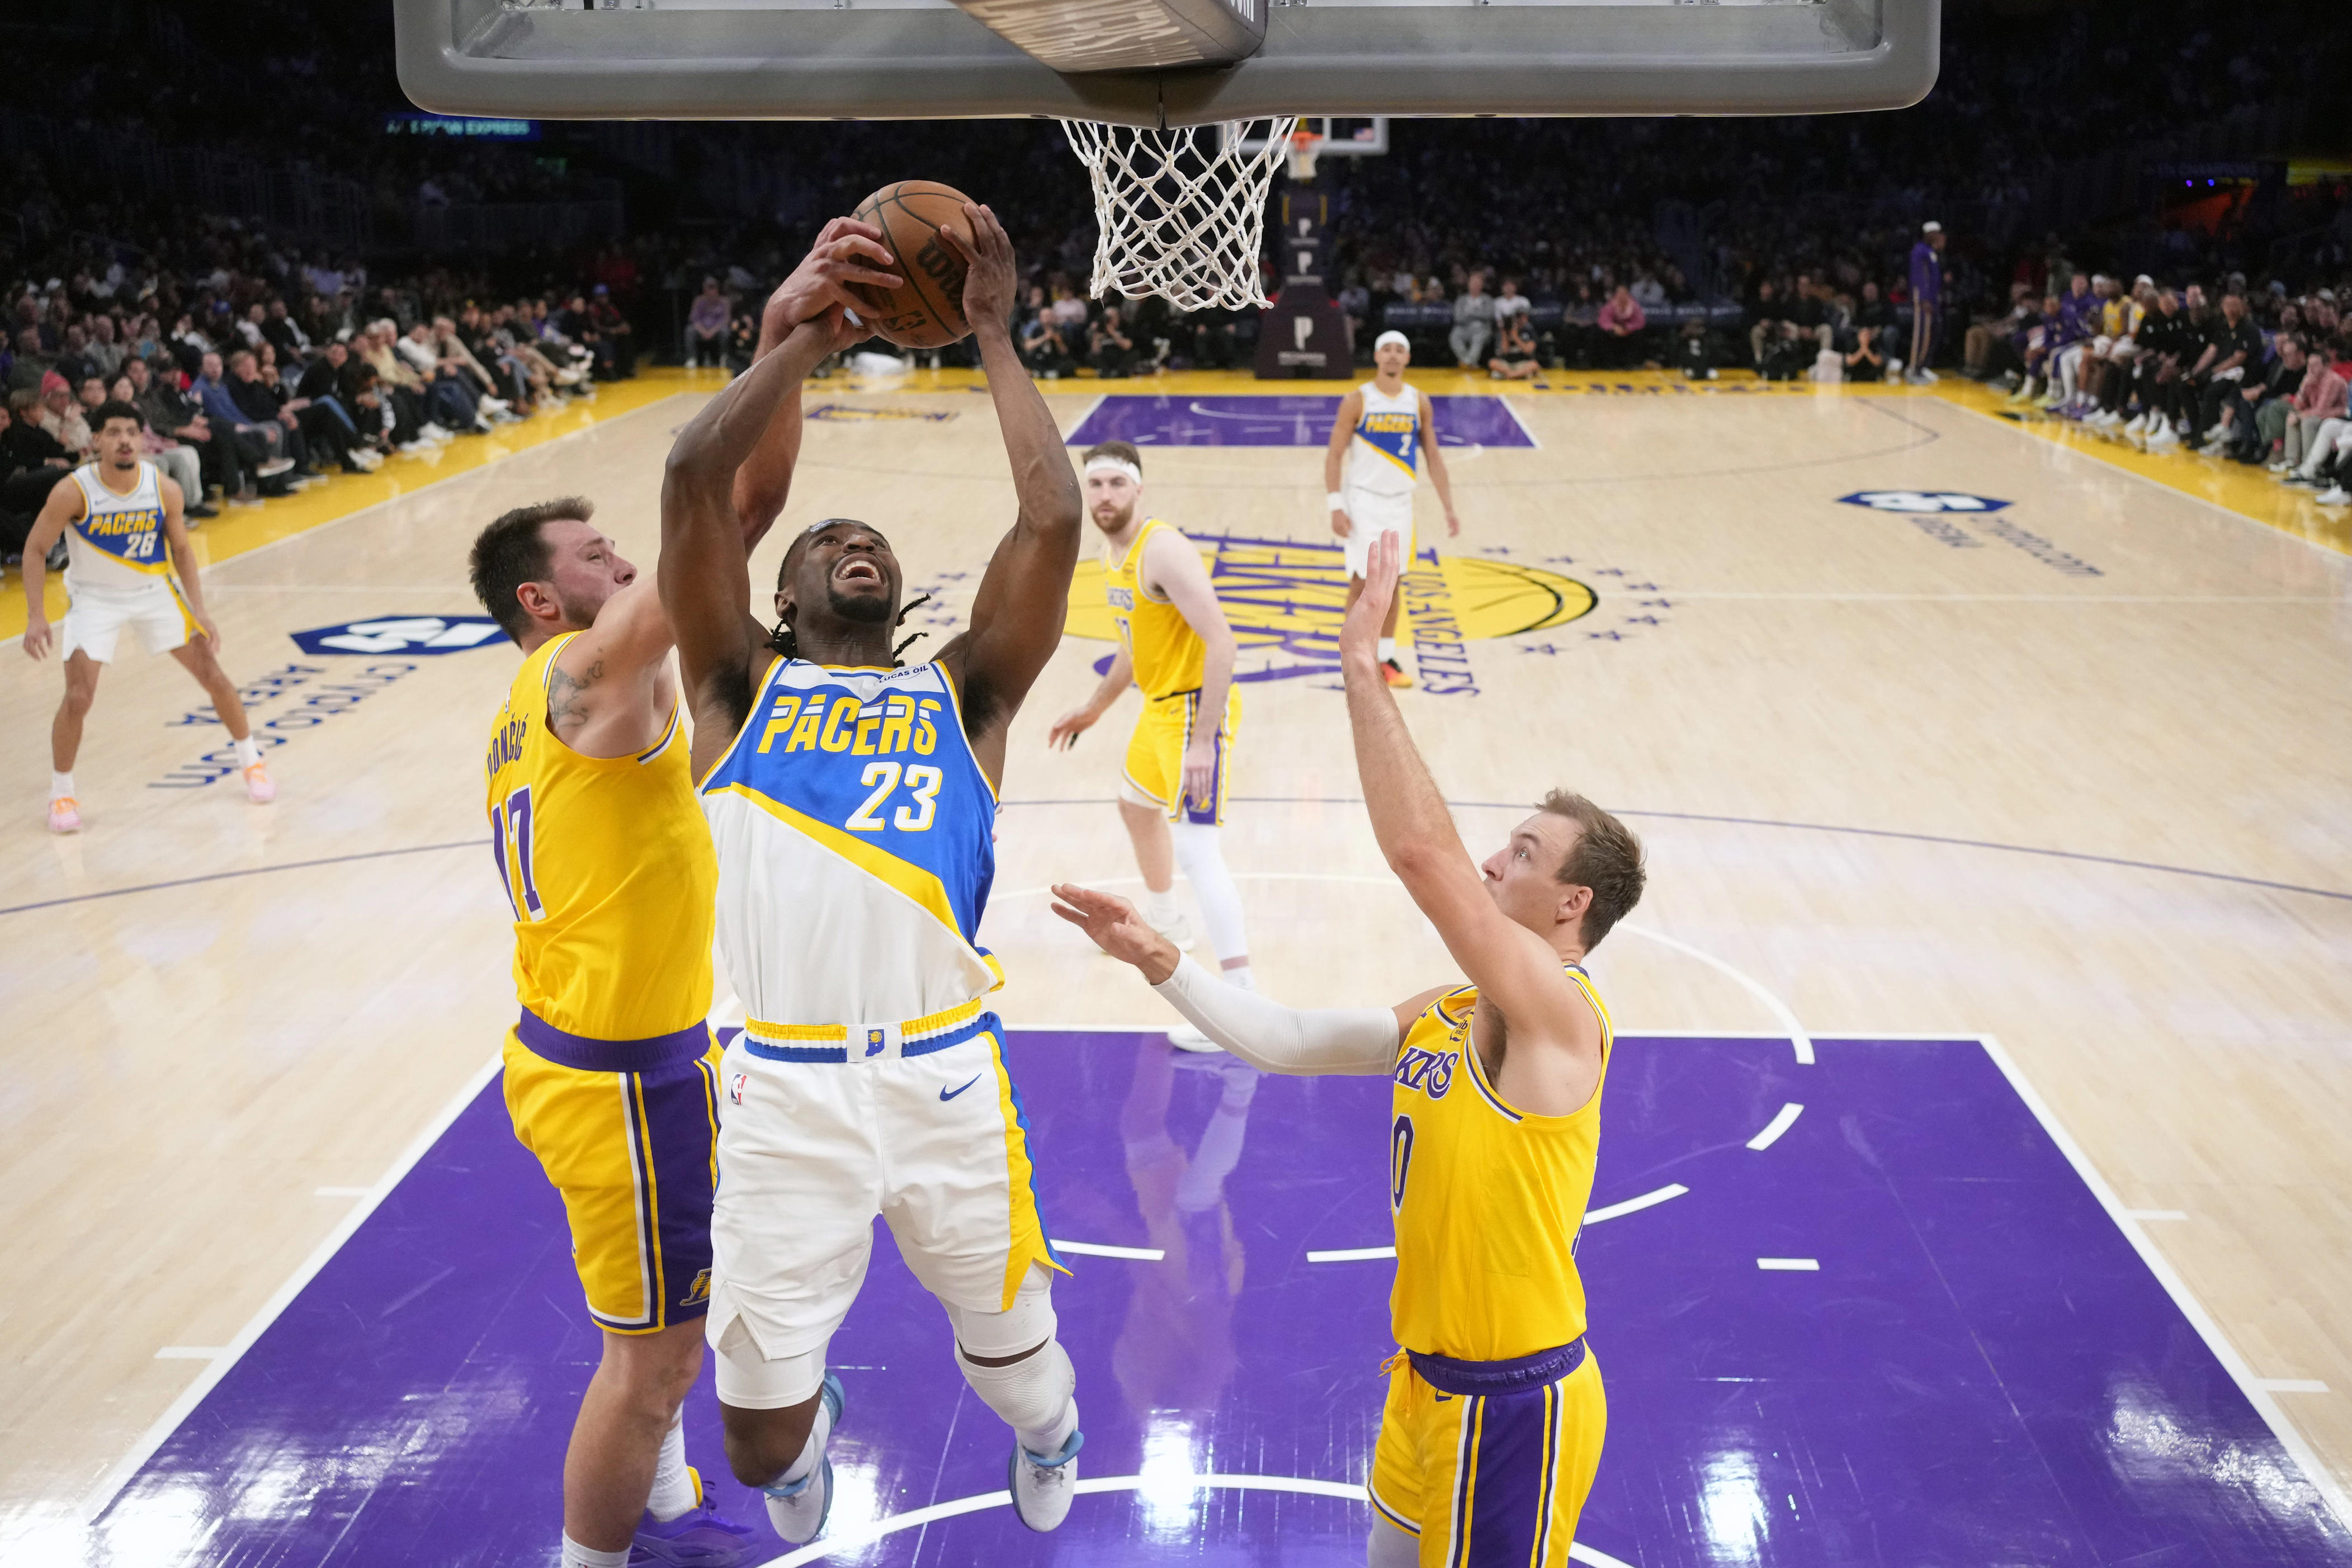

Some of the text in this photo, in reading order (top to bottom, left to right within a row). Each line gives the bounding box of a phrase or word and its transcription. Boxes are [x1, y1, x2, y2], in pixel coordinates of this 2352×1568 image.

[1365, 414, 1415, 434] PACERS
[87, 509, 159, 536] PACERS
[879, 664, 929, 683] LUCAS OIL
[756, 693, 942, 755] PACERS
[844, 761, 943, 832] 23
